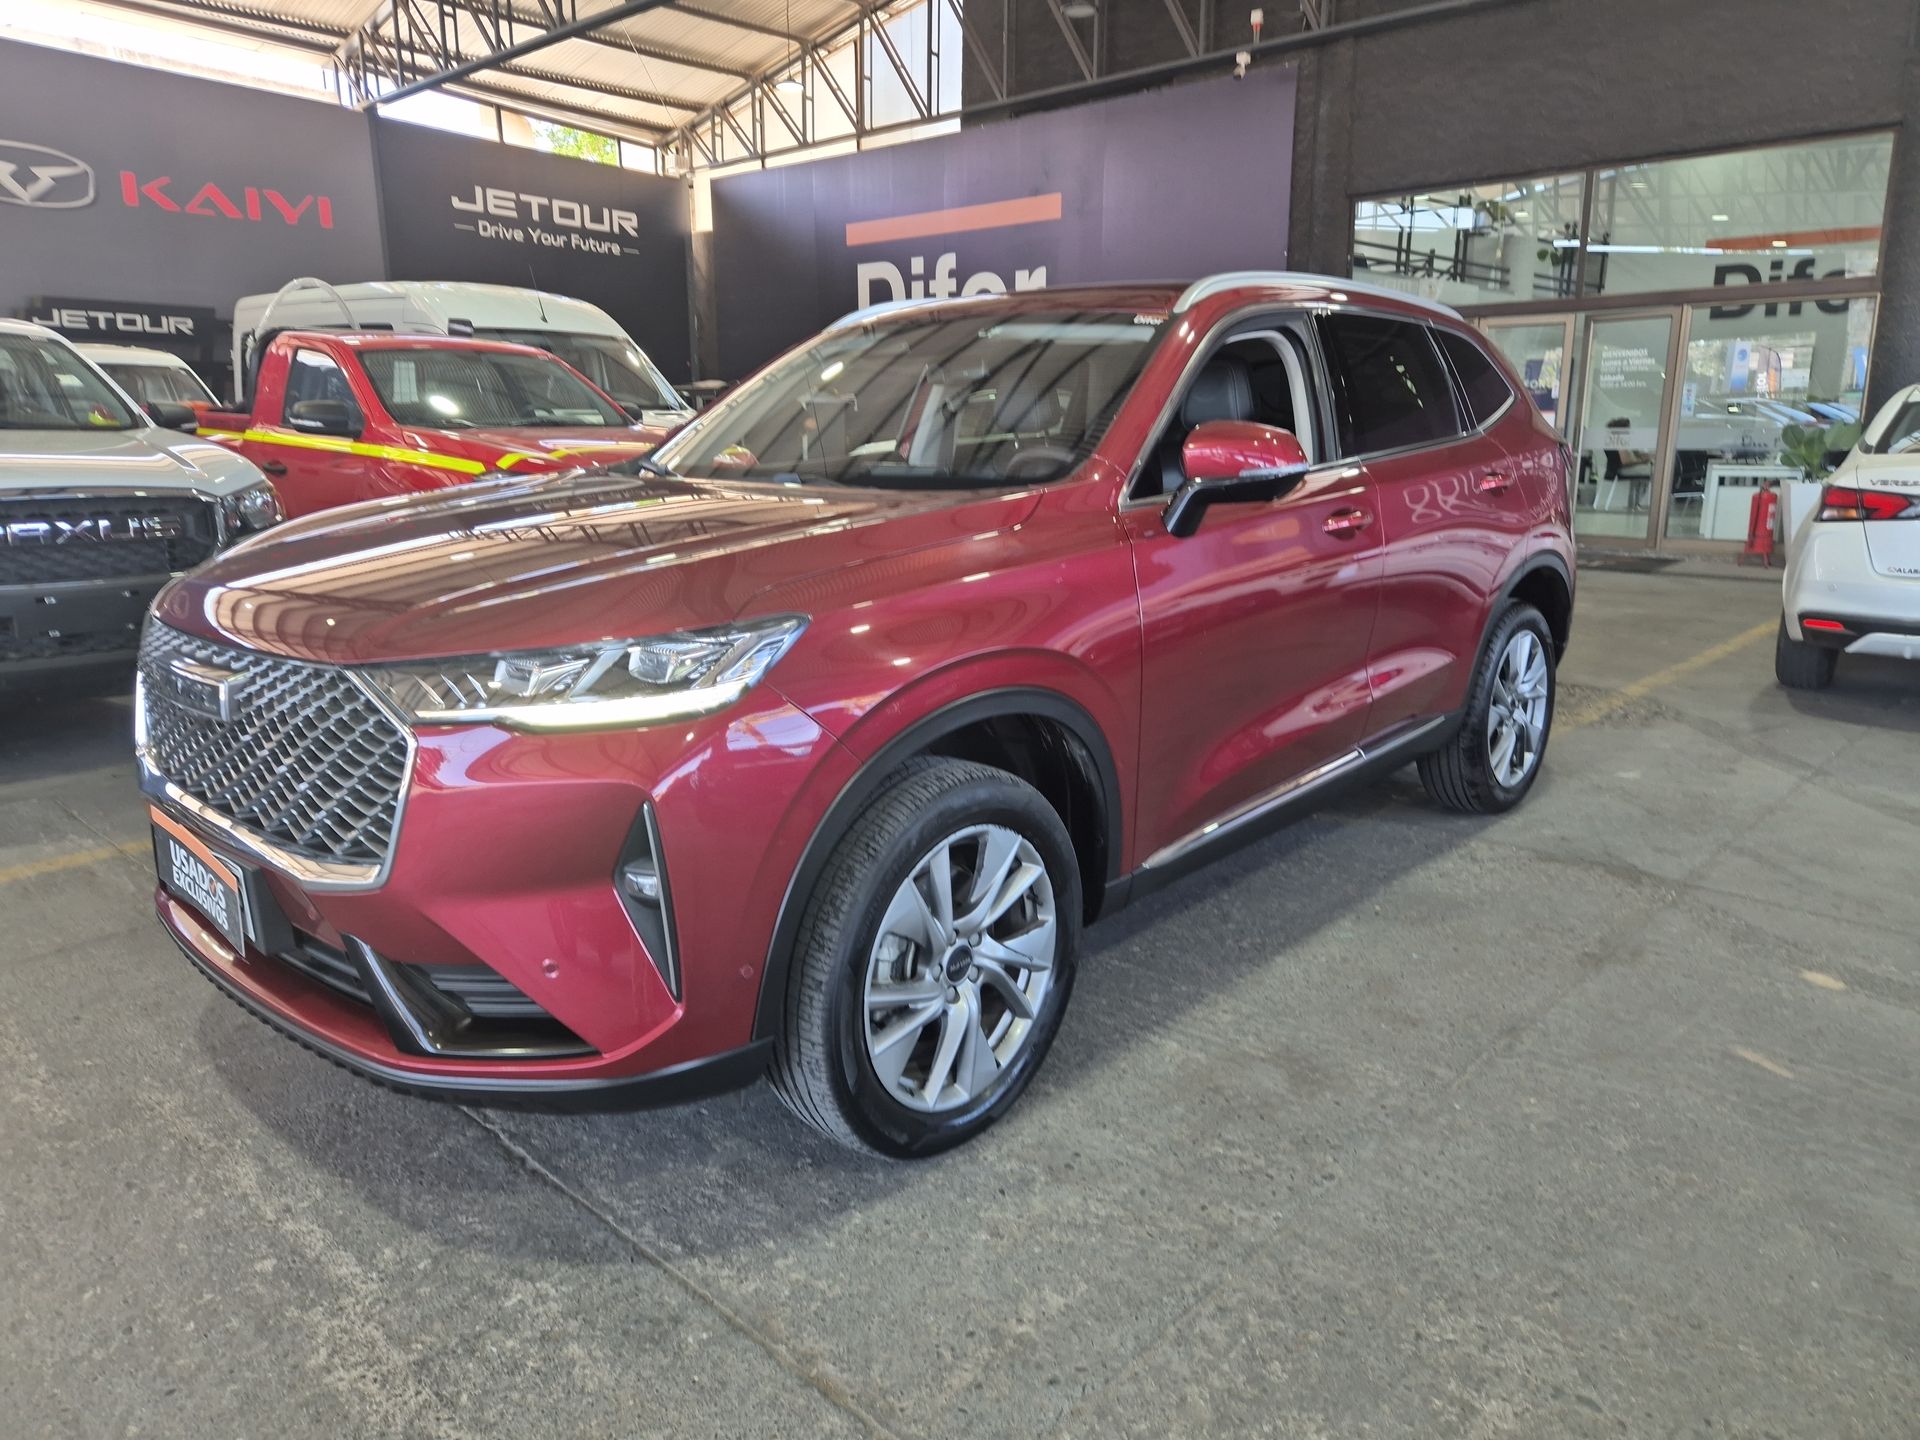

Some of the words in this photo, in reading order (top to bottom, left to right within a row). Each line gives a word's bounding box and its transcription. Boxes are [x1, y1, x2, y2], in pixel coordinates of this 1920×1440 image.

[450, 185, 639, 238] JETOUR
[477, 219, 524, 243] Drive
[527, 226, 568, 248] Your
[570, 233, 621, 256] Future
[32, 308, 195, 336] JETOUR
[0, 516, 181, 546] AXUS
[169, 839, 227, 910] USADOS
[172, 864, 229, 931] EXCLUSIVOS
